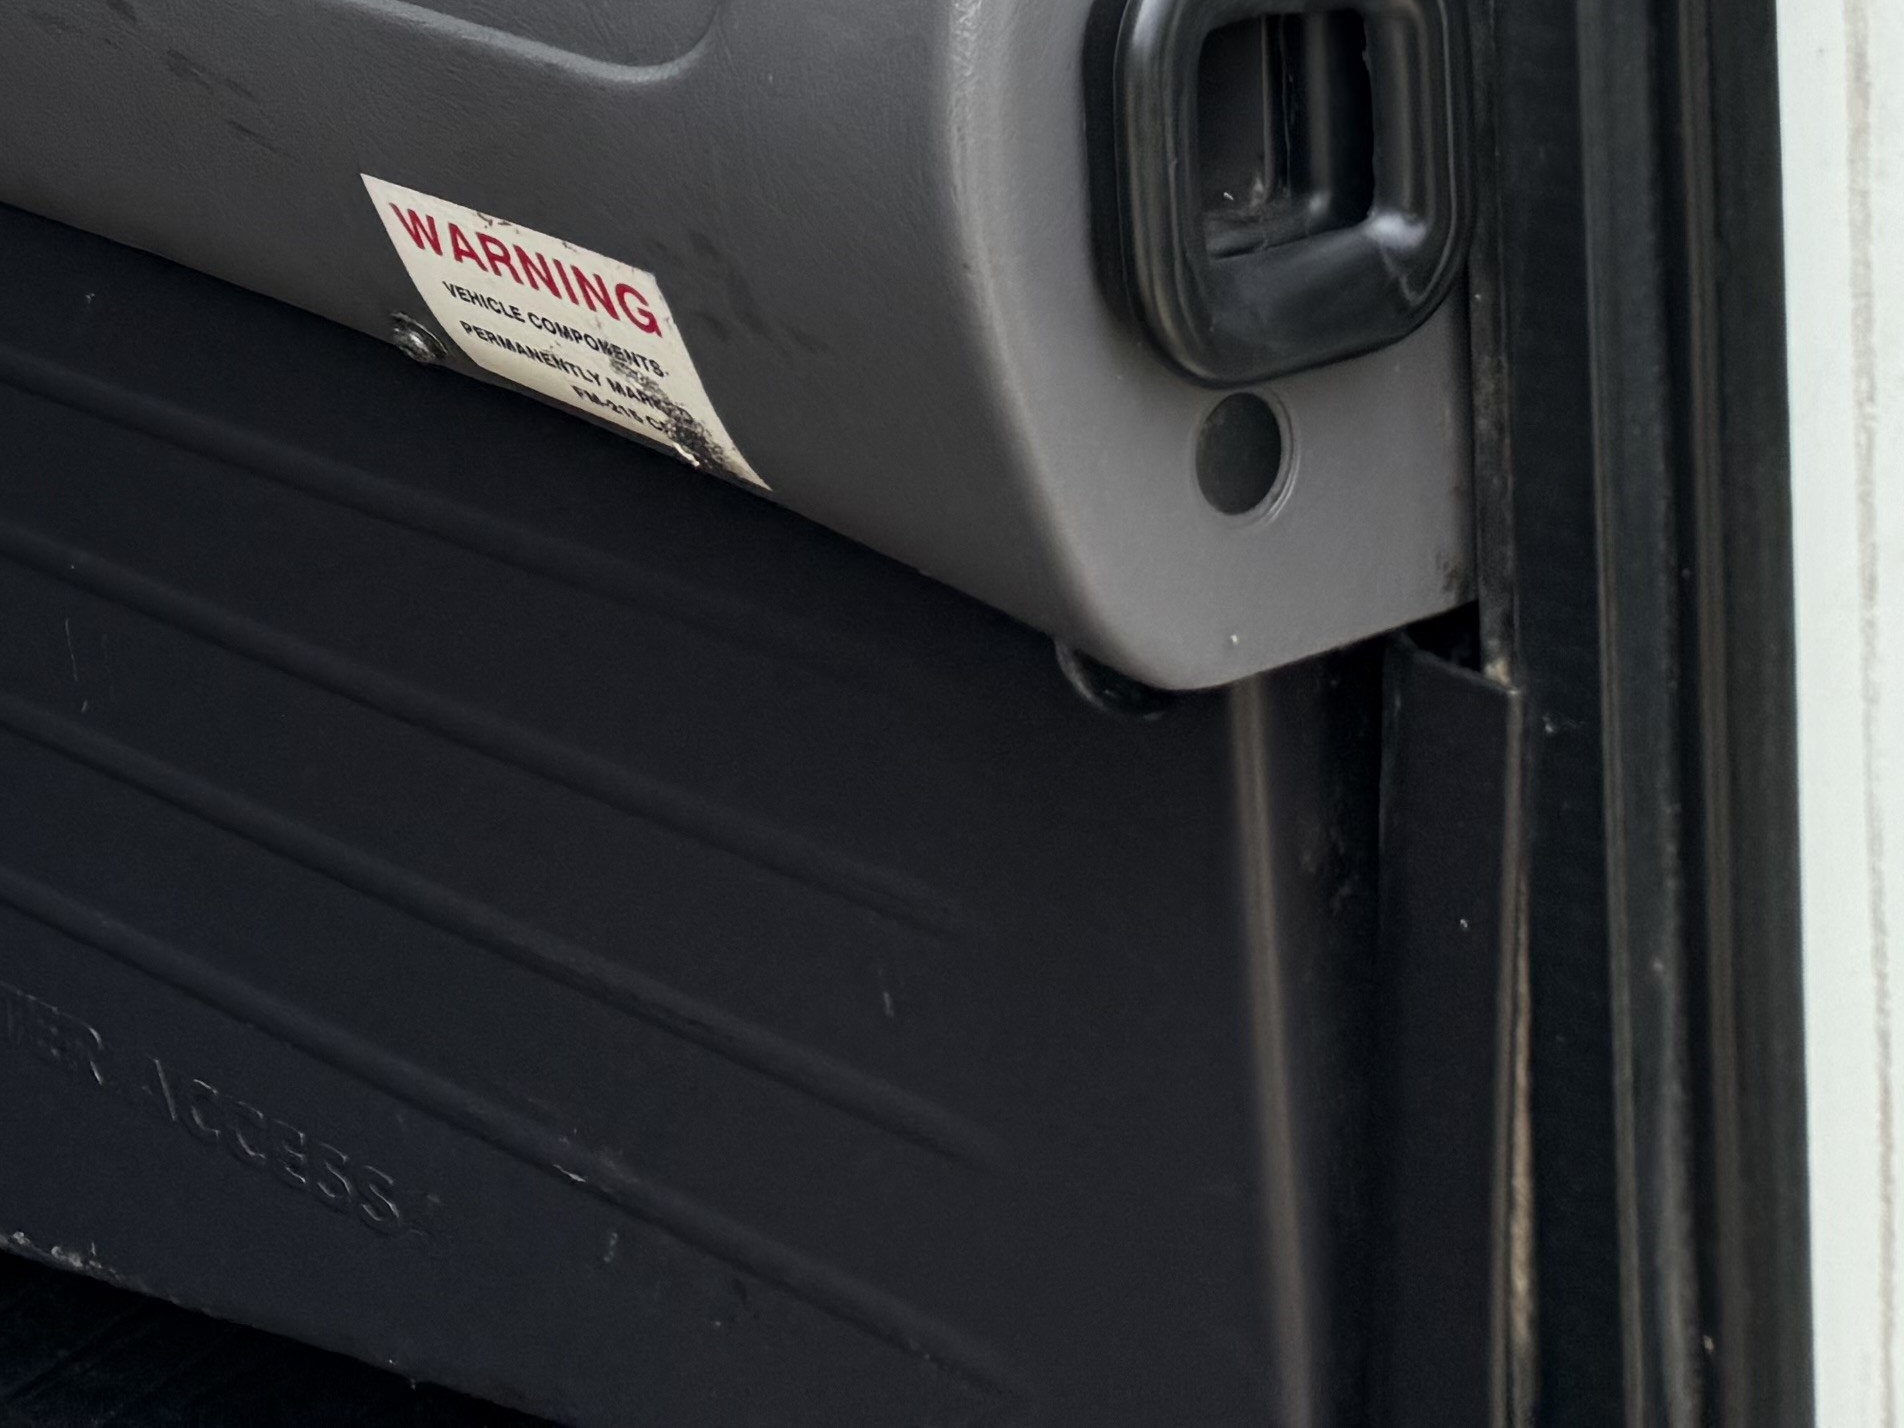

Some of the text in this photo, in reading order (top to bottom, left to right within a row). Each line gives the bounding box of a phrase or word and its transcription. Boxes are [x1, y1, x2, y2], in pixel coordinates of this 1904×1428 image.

[390, 202, 664, 338] WARNING
[443, 281, 524, 323] VEHICLE
[460, 320, 694, 422] PERMANENTLY MARK
[140, 1054, 402, 1231] ACCESS
